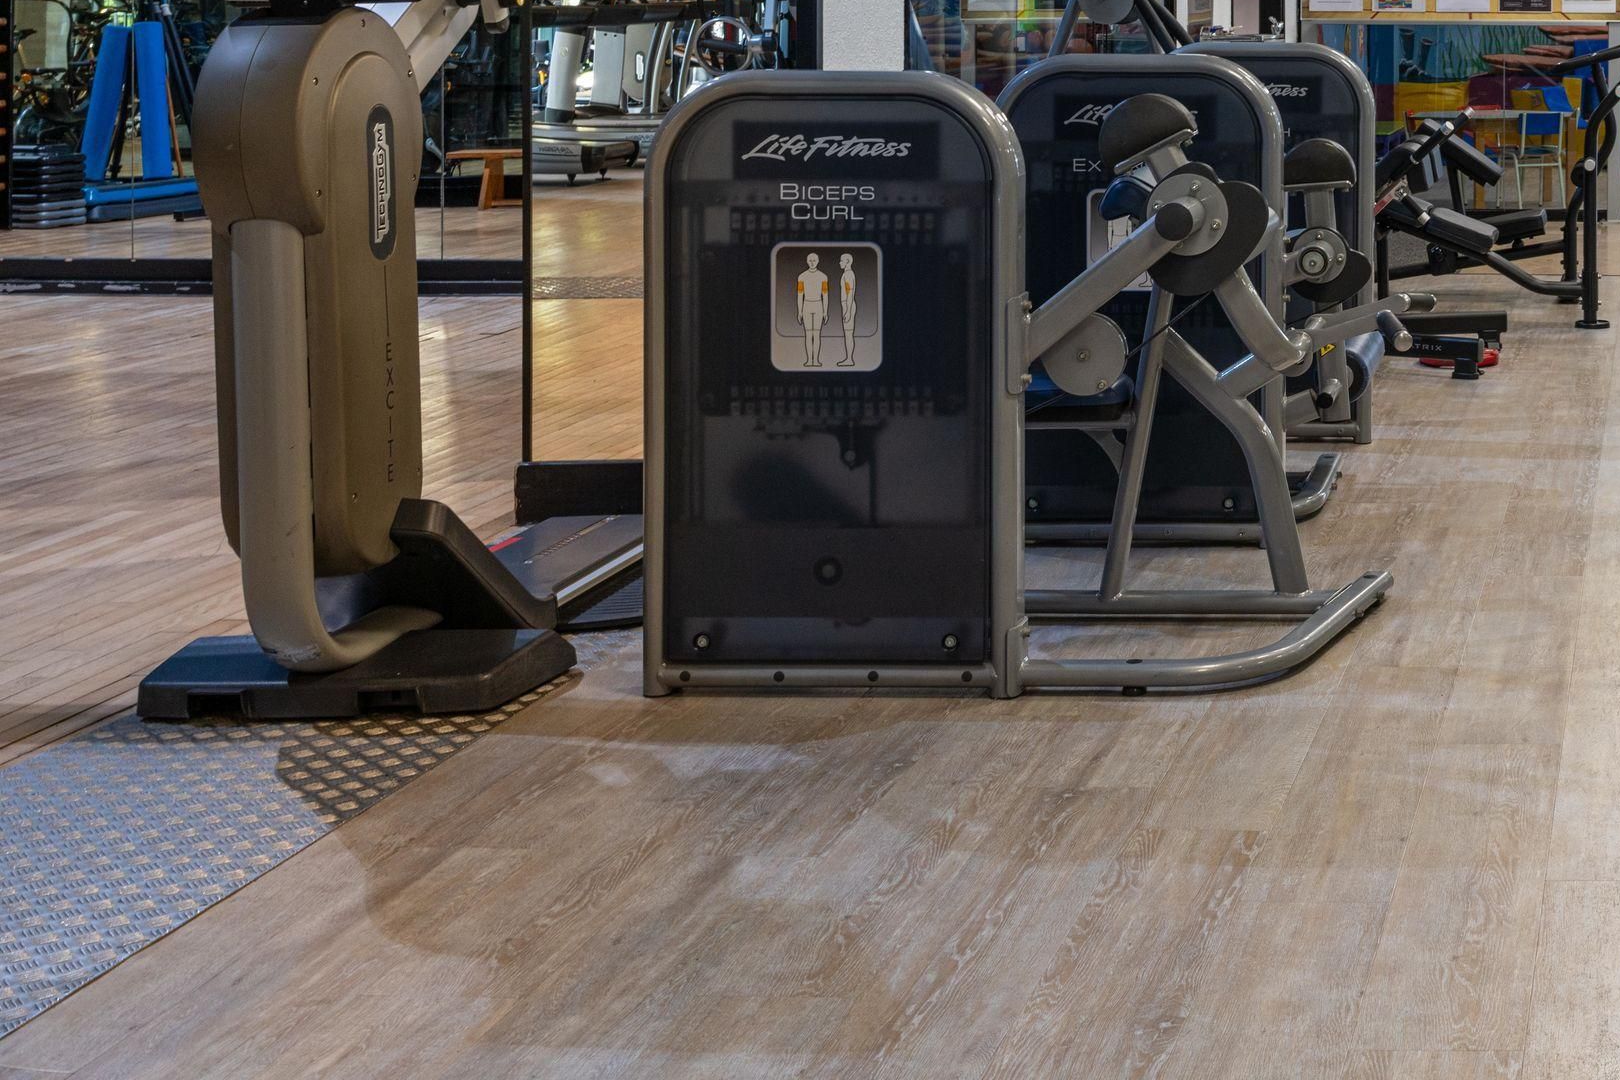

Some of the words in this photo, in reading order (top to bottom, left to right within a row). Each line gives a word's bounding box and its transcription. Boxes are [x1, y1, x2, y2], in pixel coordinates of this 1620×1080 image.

[1064, 103, 1113, 125] Lif
[374, 126, 388, 240] TECHNOGYM
[779, 183, 875, 201] BICEPS
[790, 203, 864, 221] CURL
[385, 342, 395, 482] EXCITE
